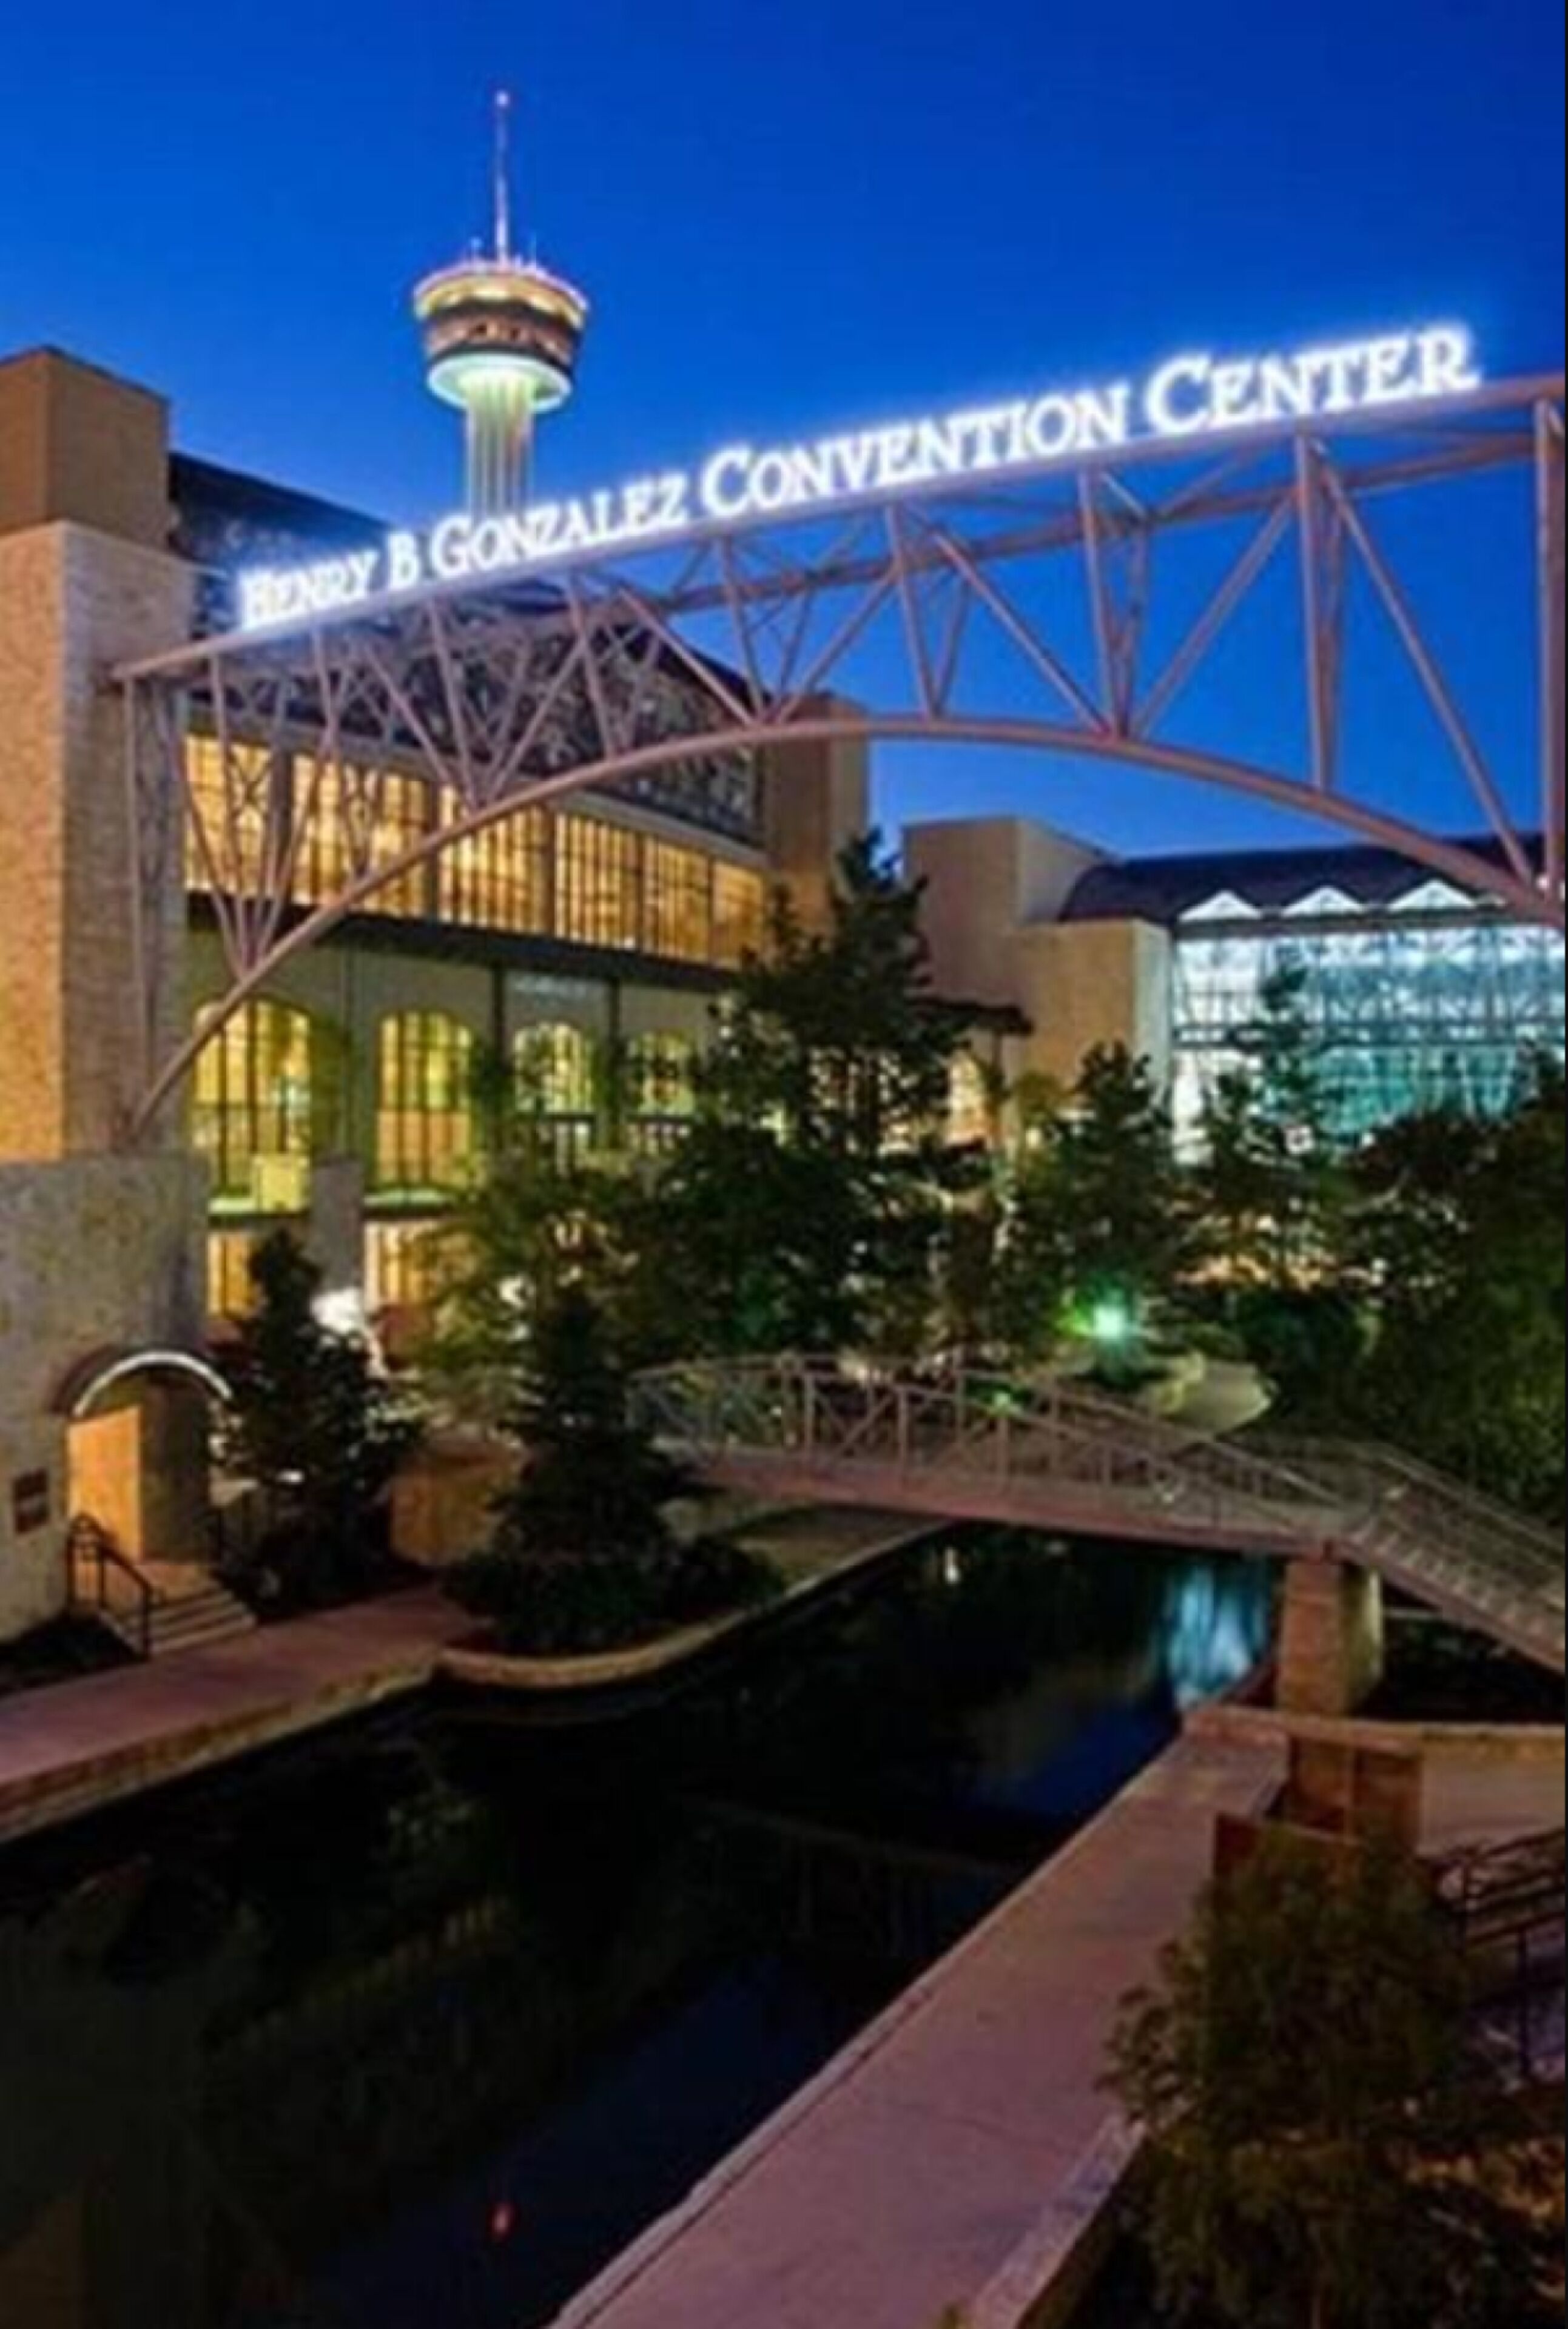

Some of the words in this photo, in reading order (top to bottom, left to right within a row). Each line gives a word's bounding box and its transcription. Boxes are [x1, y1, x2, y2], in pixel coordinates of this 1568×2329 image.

[240, 550, 377, 630] HENRY
[387, 530, 420, 590] B
[431, 474, 688, 580] GONZALEZ
[701, 385, 1129, 518] CONVENTION
[1145, 325, 1479, 432] CENTER
